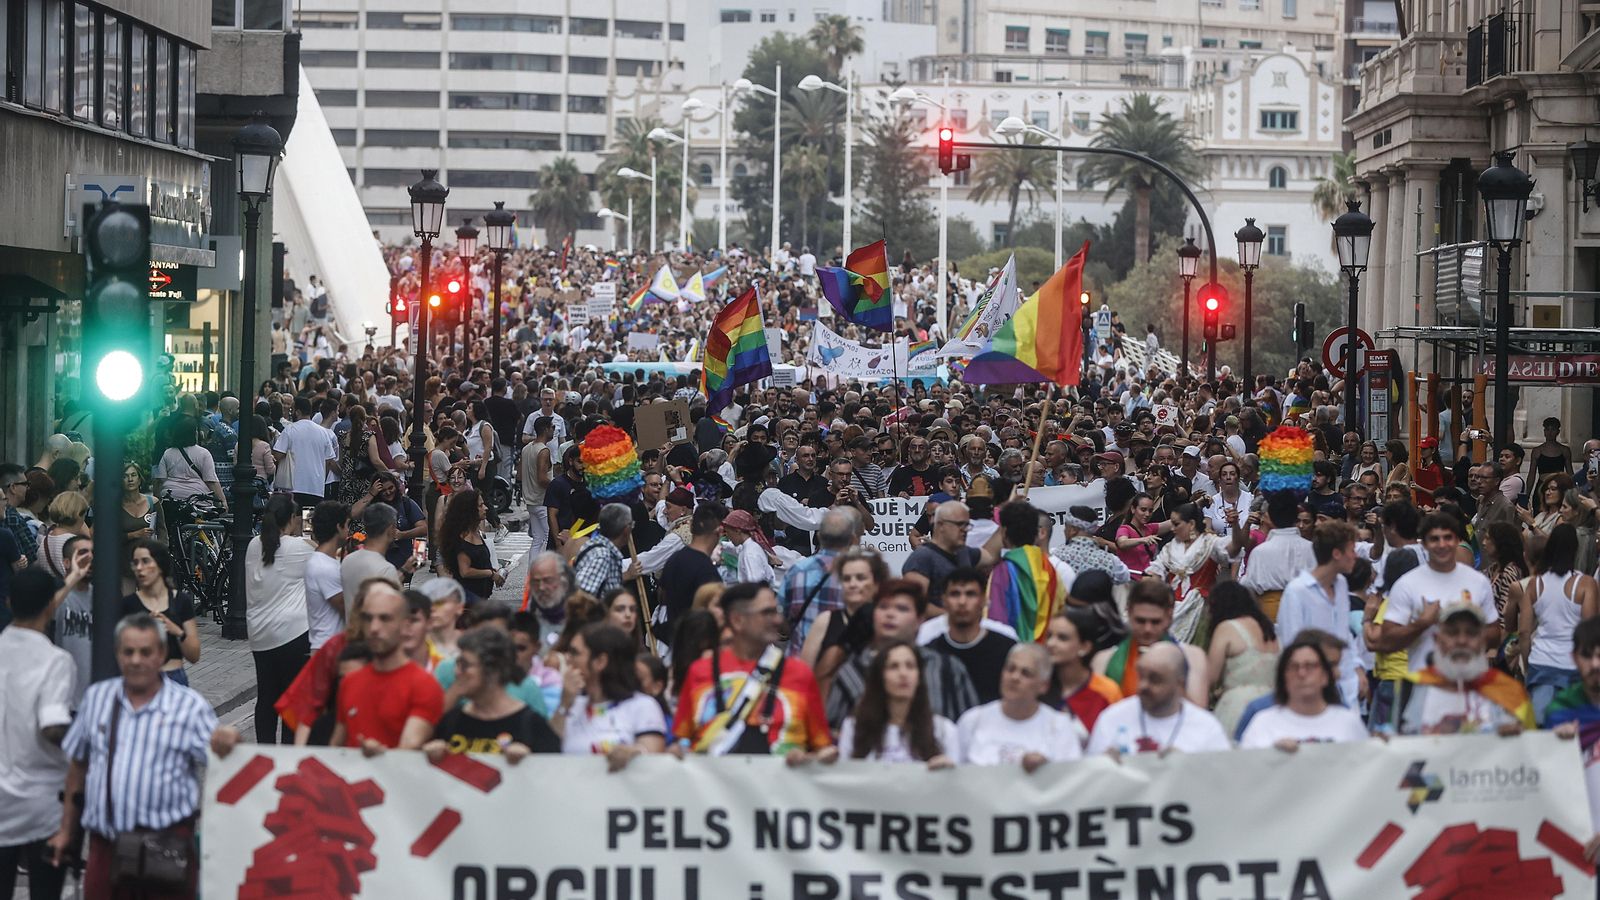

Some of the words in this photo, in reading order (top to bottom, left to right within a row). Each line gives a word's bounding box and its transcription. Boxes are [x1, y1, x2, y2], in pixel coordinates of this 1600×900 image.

[878, 541, 907, 552] Gent
[1449, 765, 1540, 787] lambda
[607, 808, 731, 850] PELS
[755, 808, 973, 855] NOSTRES
[993, 803, 1194, 854] DRETS
